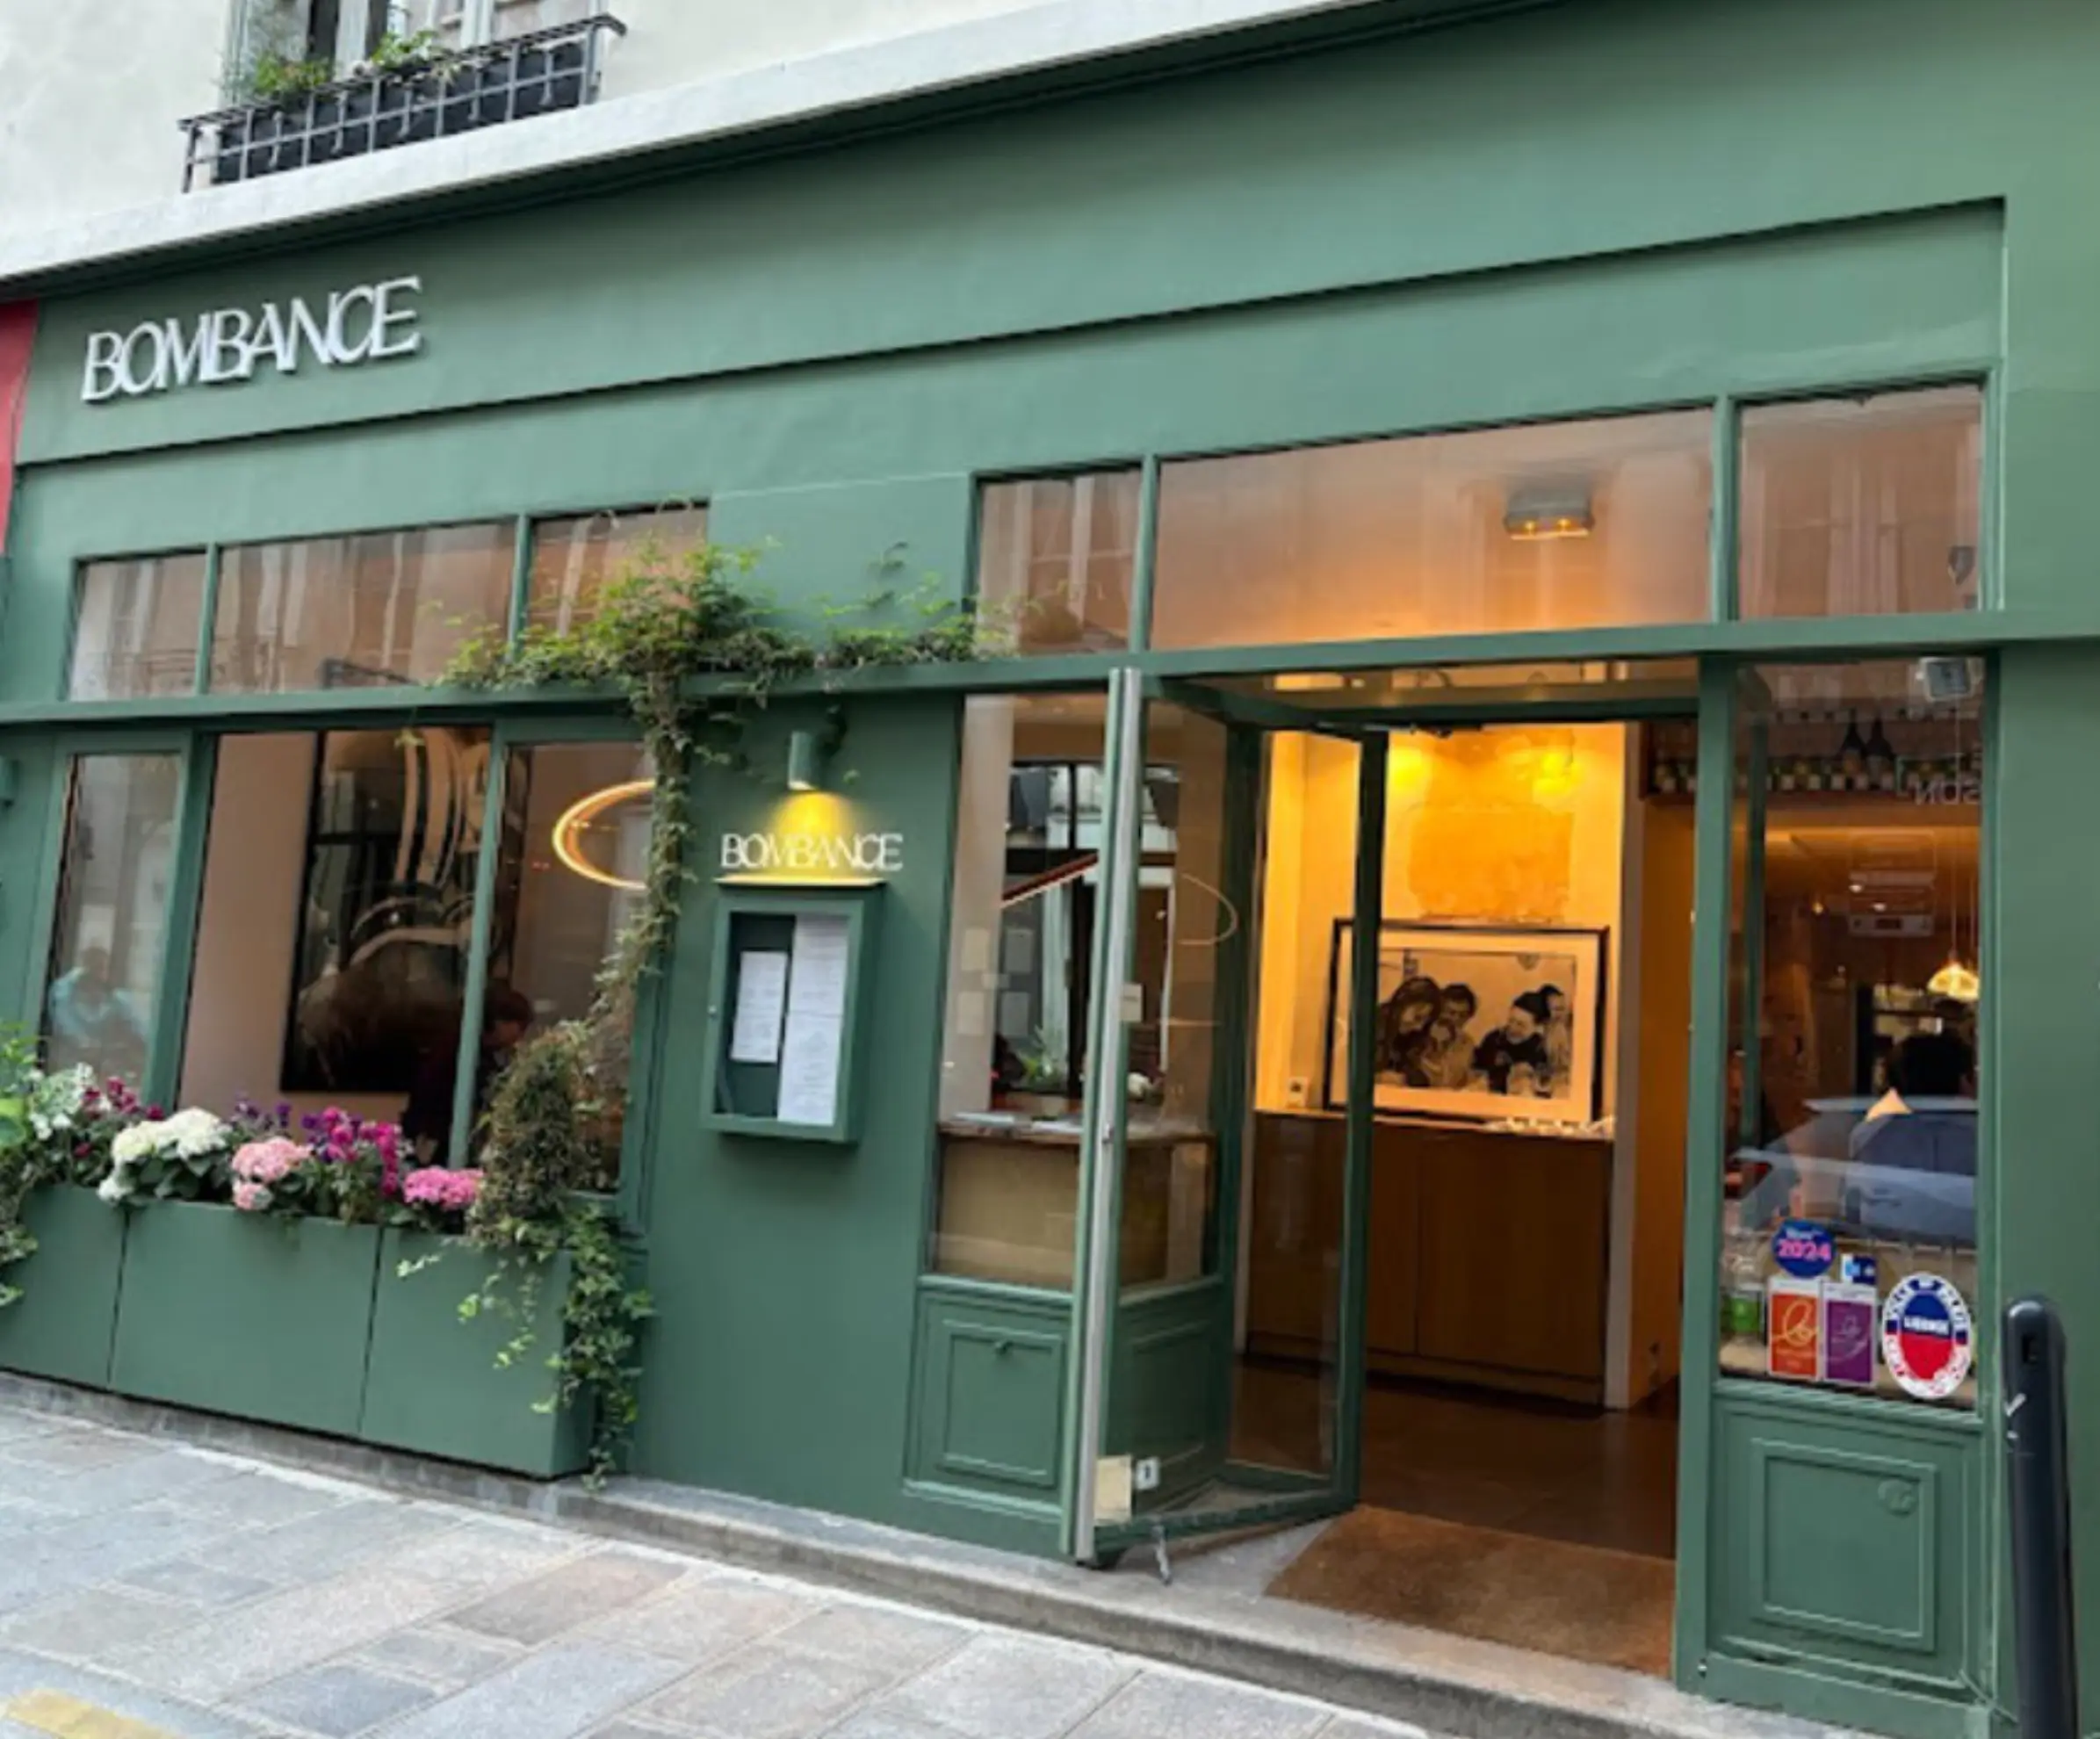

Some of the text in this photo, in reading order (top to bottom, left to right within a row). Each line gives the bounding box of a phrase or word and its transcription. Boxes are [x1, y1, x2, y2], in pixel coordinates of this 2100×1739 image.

[81, 275, 422, 402] BOMBANCE
[720, 833, 904, 871] BOMBANCE
[1777, 1239, 1831, 1261] 2024
